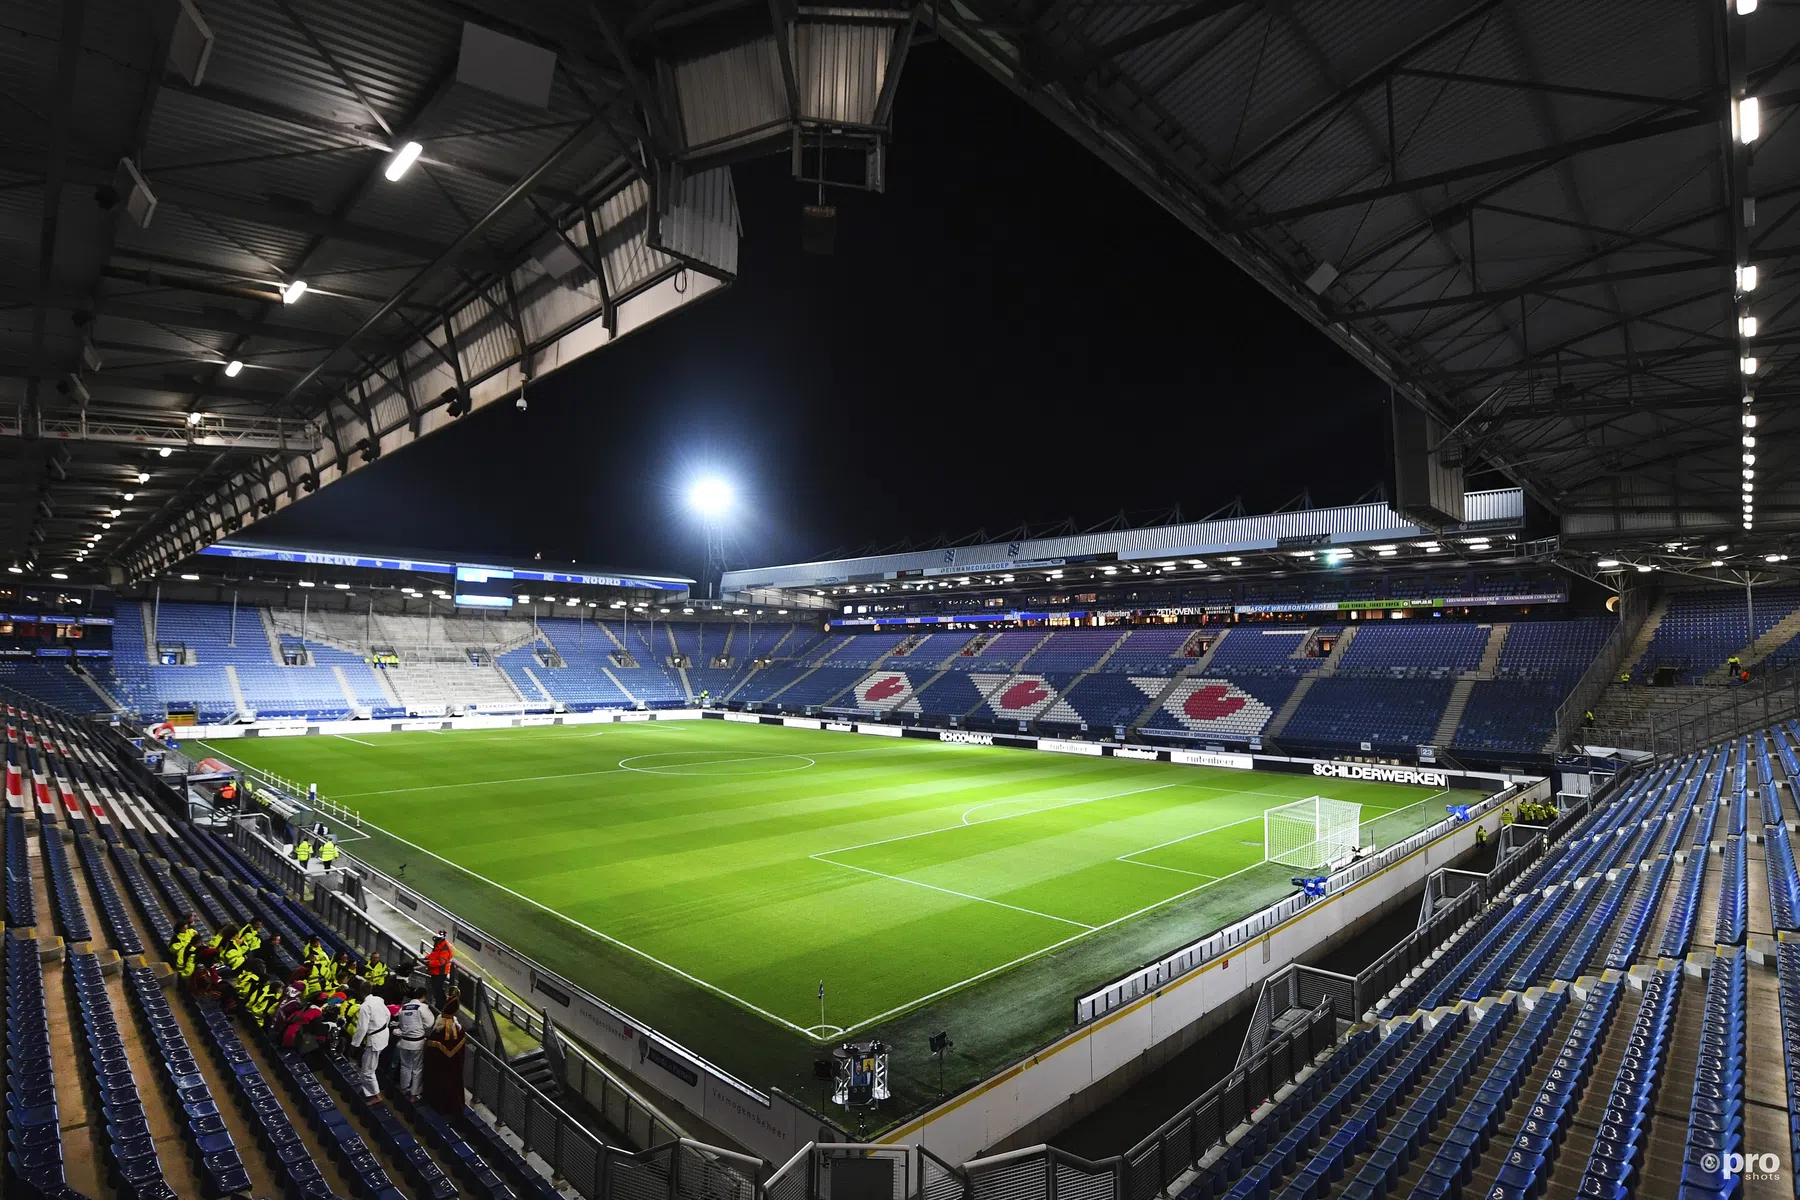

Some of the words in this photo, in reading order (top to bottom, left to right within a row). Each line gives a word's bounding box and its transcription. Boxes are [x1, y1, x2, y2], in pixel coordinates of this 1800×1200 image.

[305, 553, 359, 567] NIEUW
[582, 576, 621, 586] NOORD
[1156, 607, 1202, 616] ZETHOVEN.NL
[940, 731, 994, 746] SCHOONMAAK
[1250, 736, 1261, 744] 22
[1422, 748, 1432, 756] 23
[1312, 763, 1446, 787] SCHILDERWERKEN
[712, 1087, 786, 1140] Vermogensbeheer
